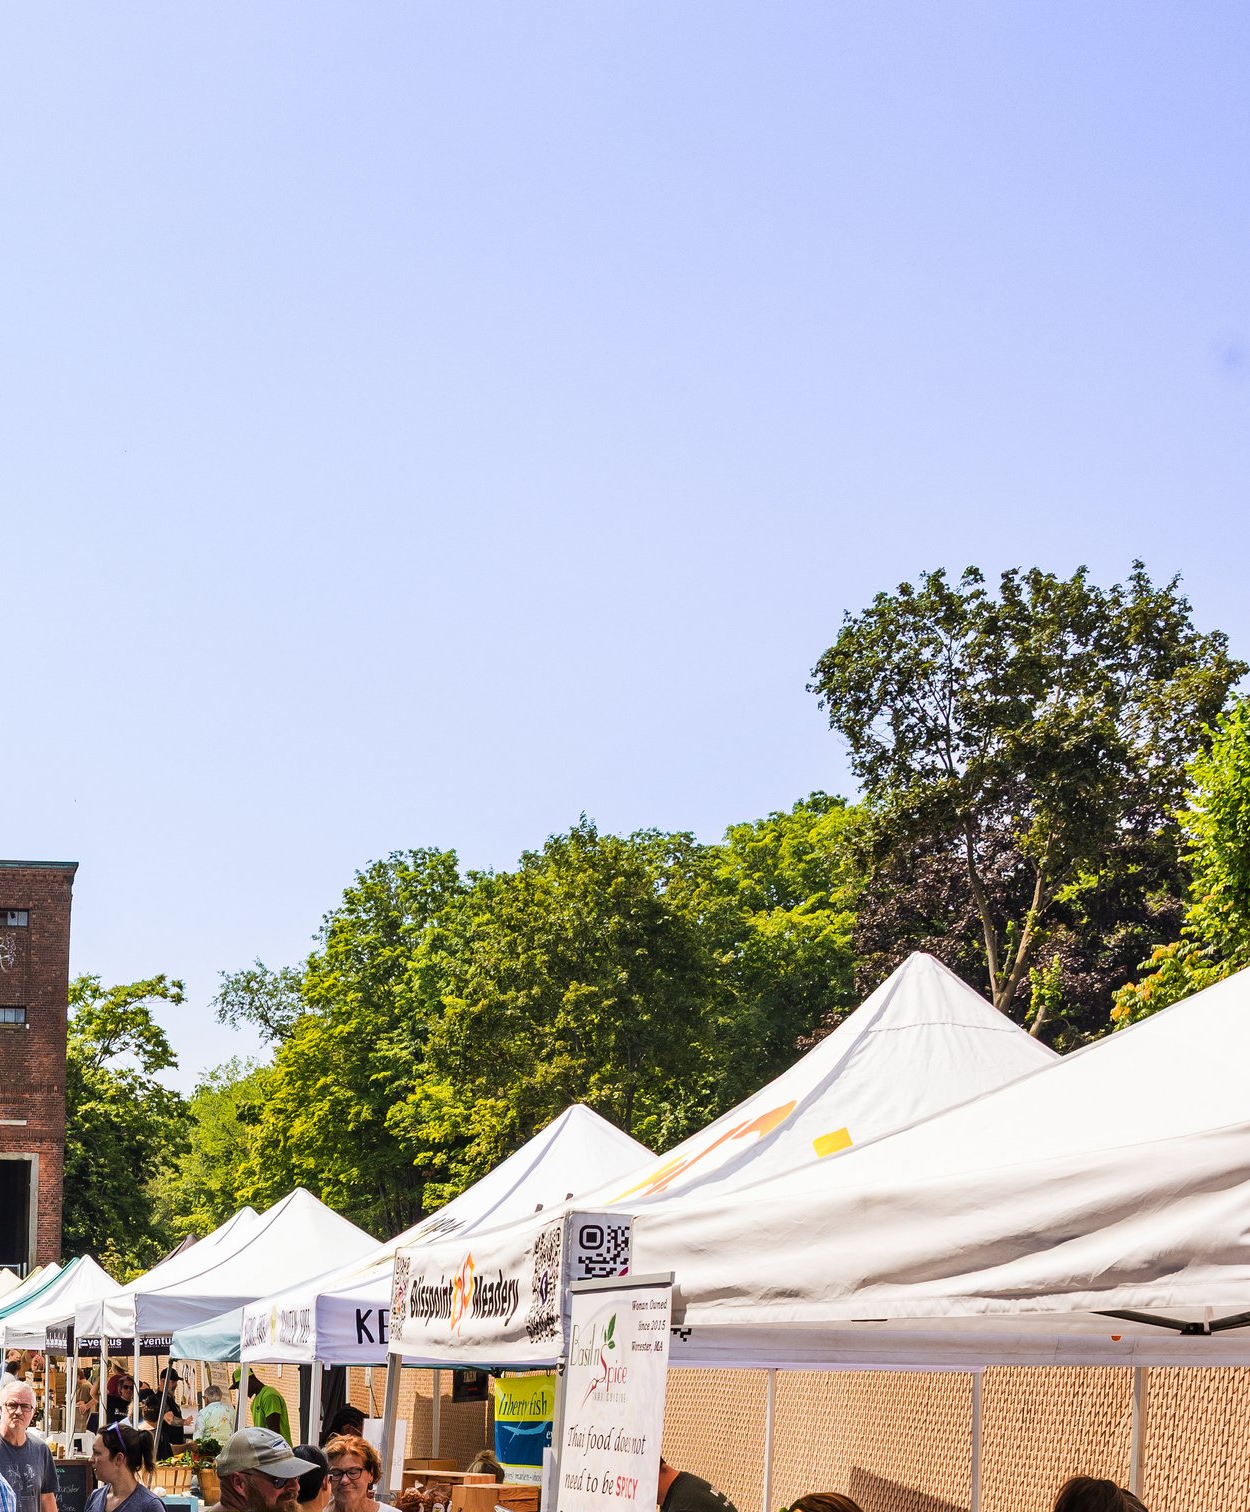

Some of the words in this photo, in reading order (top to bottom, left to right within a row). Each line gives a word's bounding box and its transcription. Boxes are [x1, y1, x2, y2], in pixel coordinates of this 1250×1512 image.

[410, 1275, 452, 1327] Blisspoint
[471, 1268, 520, 1327] Meadery
[651, 1320, 666, 1331] 2015
[567, 1424, 586, 1448] Thai
[584, 1425, 615, 1457] food
[614, 1427, 631, 1453] does
[631, 1435, 647, 1455] not
[564, 1468, 587, 1491] need
[586, 1473, 599, 1493] to
[601, 1470, 614, 1495] be
[615, 1475, 639, 1500] SPICY
